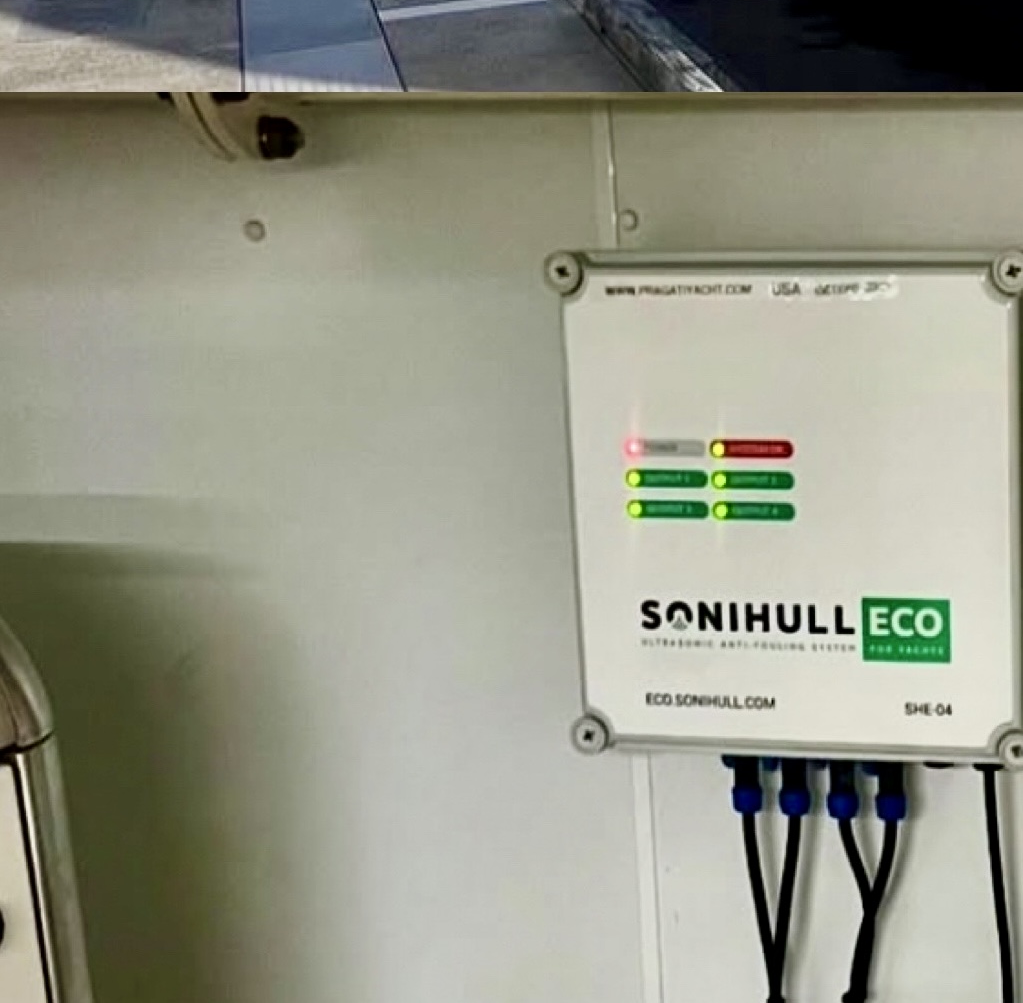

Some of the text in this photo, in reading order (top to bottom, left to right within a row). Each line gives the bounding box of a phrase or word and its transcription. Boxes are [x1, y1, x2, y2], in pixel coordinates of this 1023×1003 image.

[772, 282, 801, 296] USA
[641, 599, 943, 637] SONIHULL ECO
[641, 638, 714, 650] ULTRASONIC
[812, 642, 857, 653] SYSTEM
[645, 692, 776, 710] ECO.SONIHULL.COM
[904, 701, 953, 717] SHE-04
